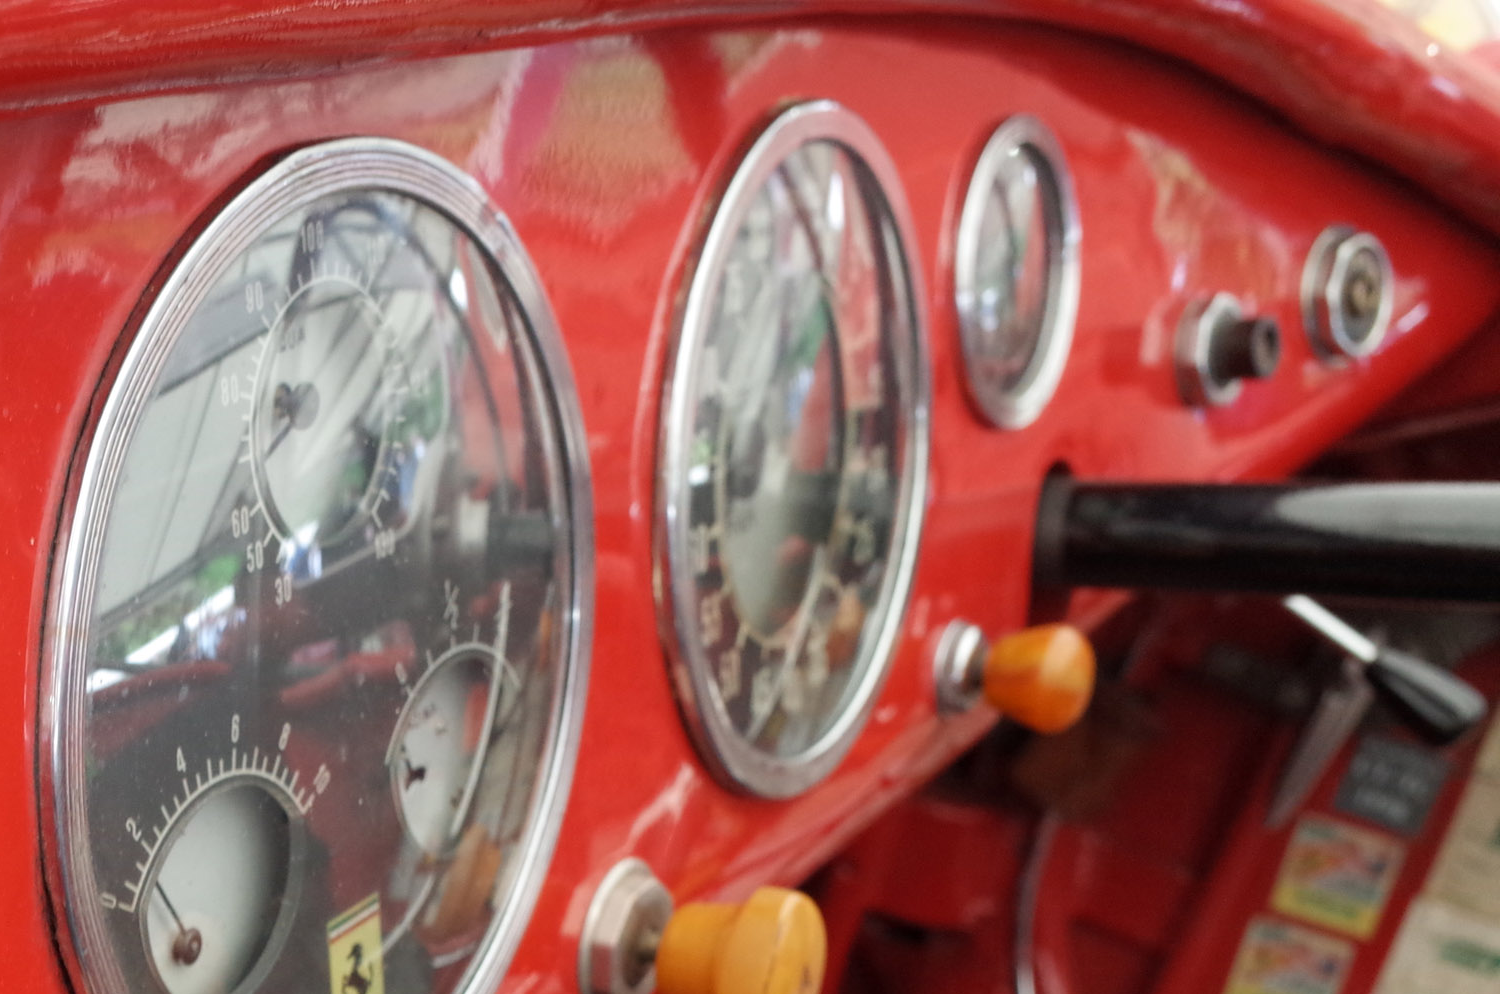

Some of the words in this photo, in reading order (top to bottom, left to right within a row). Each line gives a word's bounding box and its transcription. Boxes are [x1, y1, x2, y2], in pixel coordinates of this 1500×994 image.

[231, 505, 250, 538] 60
[246, 541, 264, 573] 50
[274, 574, 293, 606] 30
[176, 745, 188, 773] 4
[126, 816, 144, 843] 2
